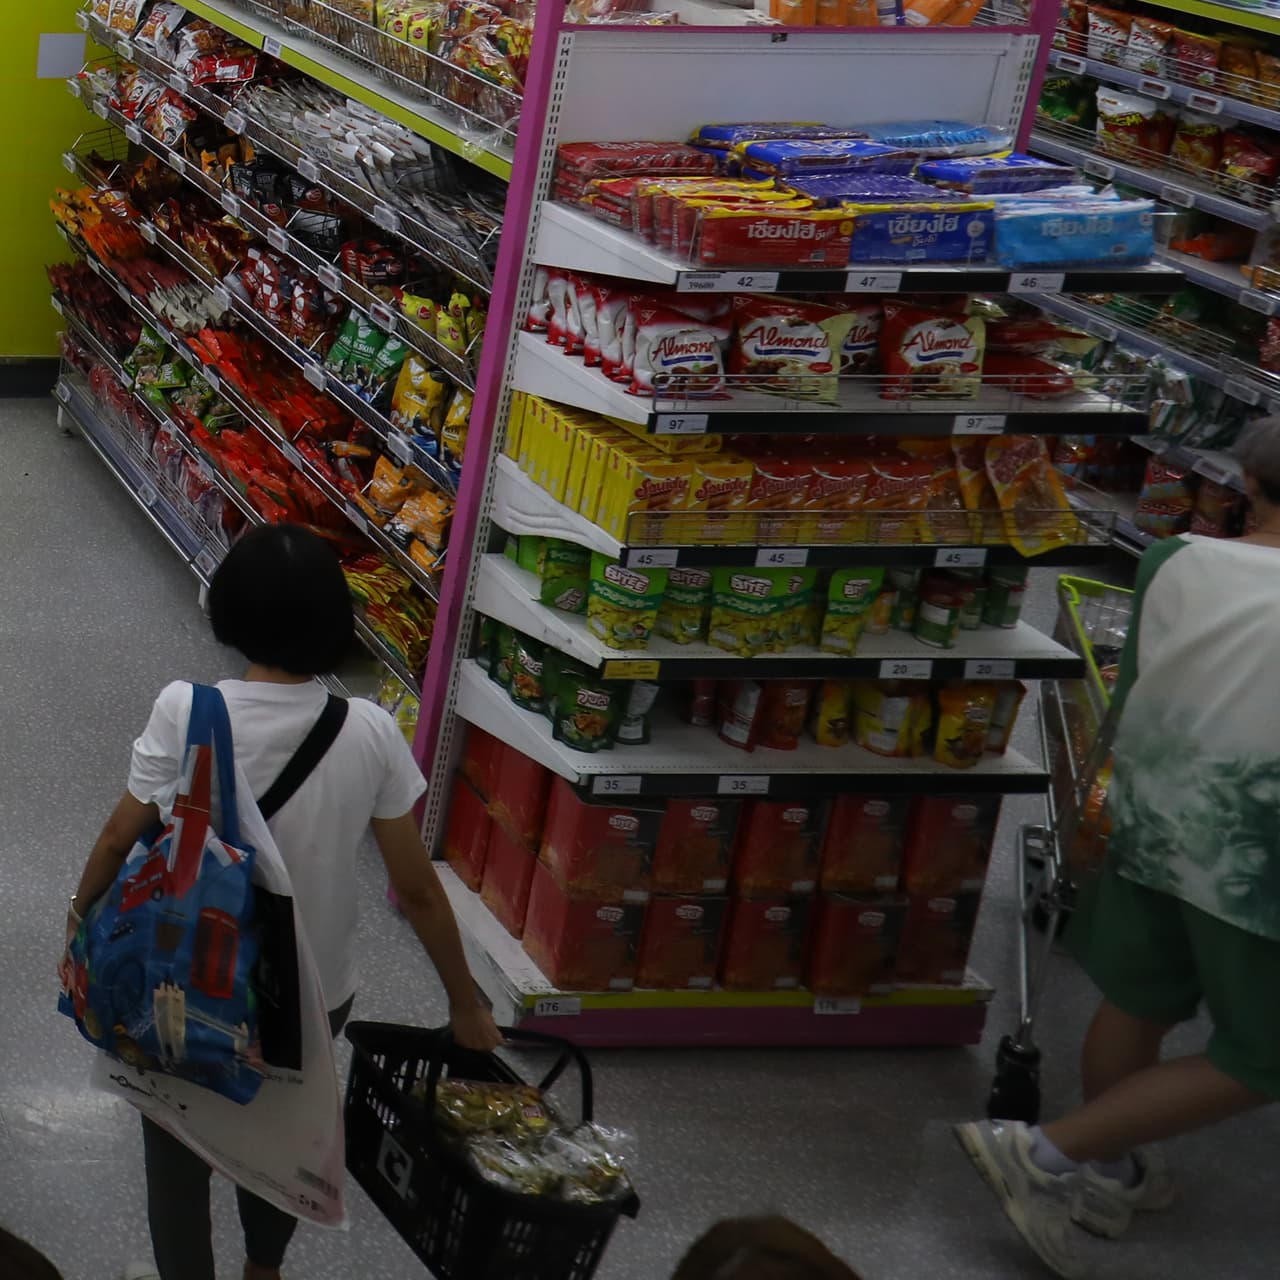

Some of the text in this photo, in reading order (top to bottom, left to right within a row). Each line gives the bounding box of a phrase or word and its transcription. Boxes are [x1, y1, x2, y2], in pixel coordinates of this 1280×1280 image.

[737, 275, 753, 287] 42
[860, 275, 877, 287] 47
[1020, 277, 1037, 289] 46
[743, 325, 830, 350] Almond
[901, 331, 975, 353] Almond
[652, 337, 715, 361] Almon
[669, 419, 685, 430] 97
[967, 417, 983, 428] 97
[637, 553, 653, 566] 45
[769, 552, 785, 564] 45
[945, 552, 961, 564] 45
[893, 662, 910, 675] 20
[976, 663, 993, 675] 20
[603, 780, 619, 791] 35
[732, 780, 747, 791] 35
